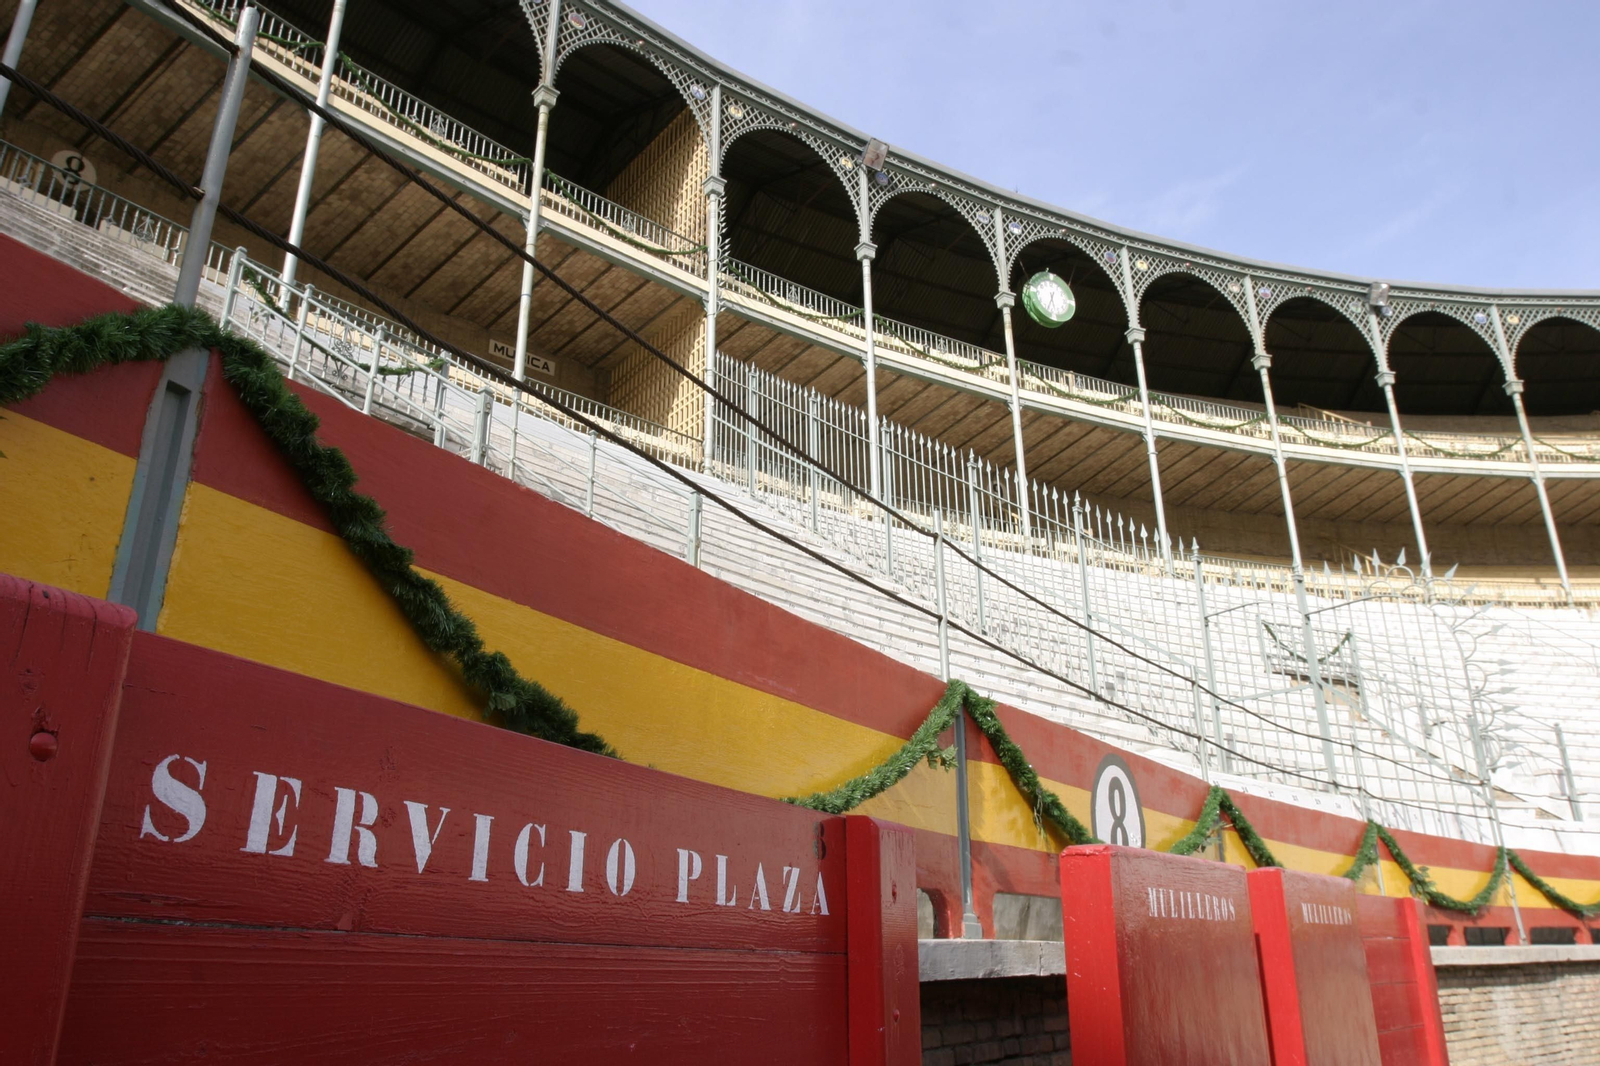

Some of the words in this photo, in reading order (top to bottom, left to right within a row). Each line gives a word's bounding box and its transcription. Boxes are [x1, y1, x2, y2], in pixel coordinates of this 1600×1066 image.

[494, 343, 550, 372] MUICA
[140, 754, 636, 896] SERVICIO
[676, 848, 829, 915] PLAZA
[1108, 776, 1129, 847] 8
[1147, 887, 1236, 921] MULILLEROS
